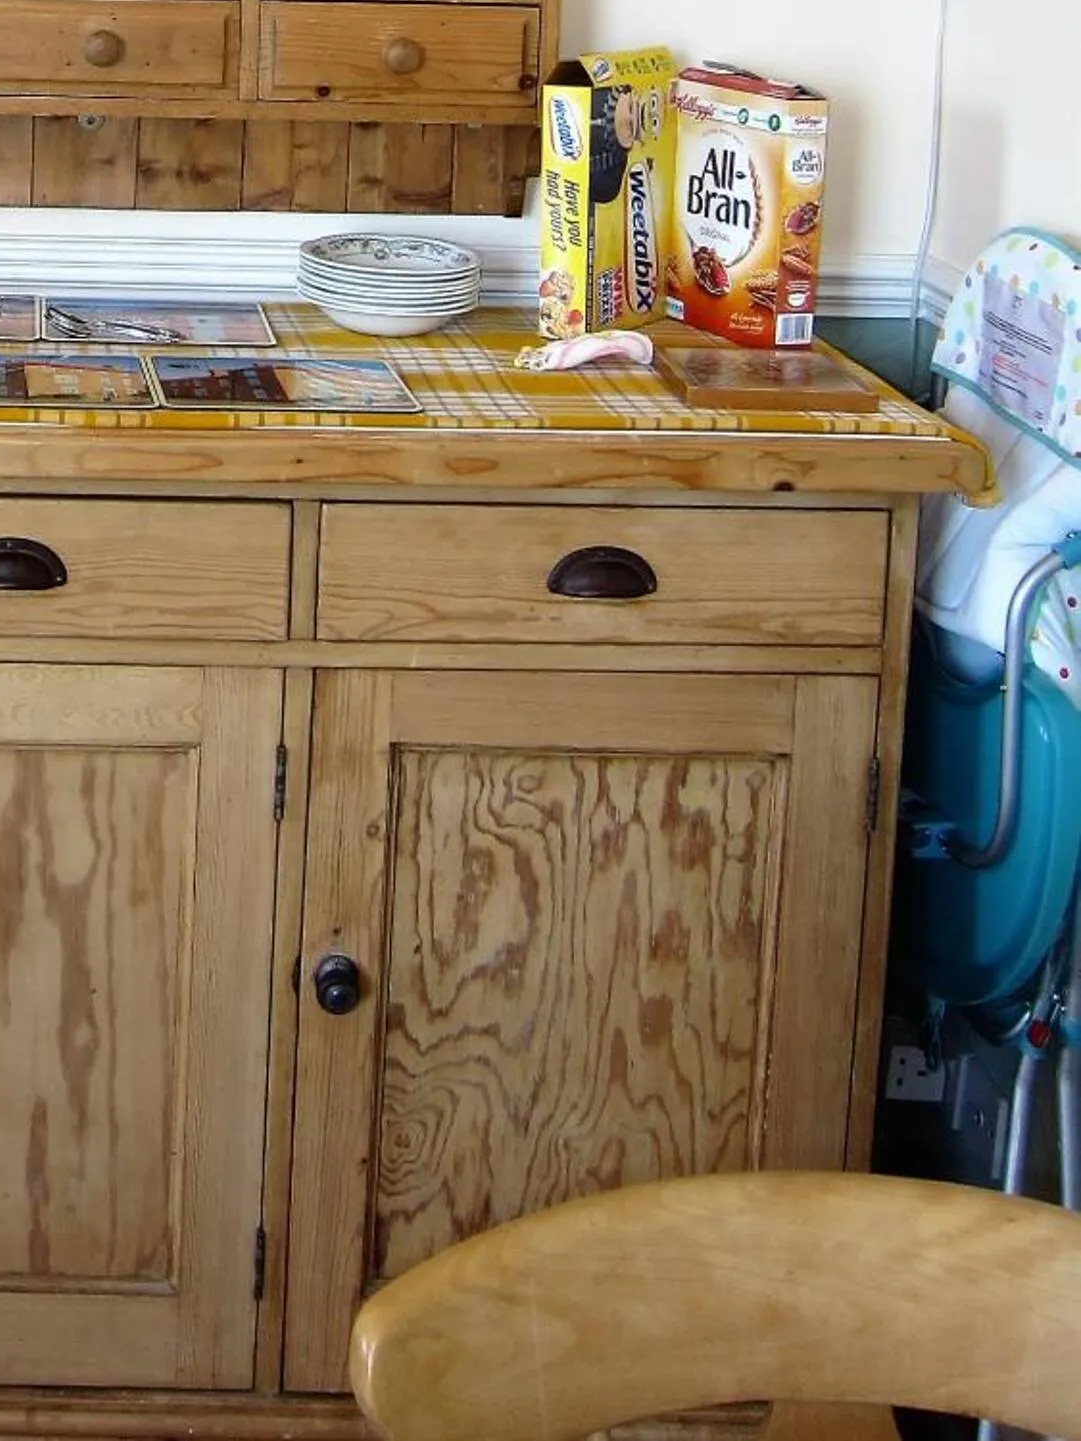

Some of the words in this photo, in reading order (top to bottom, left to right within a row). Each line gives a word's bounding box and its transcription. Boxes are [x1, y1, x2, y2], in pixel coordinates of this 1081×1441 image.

[545, 169, 562, 201] had
[701, 147, 746, 188] All-
[792, 160, 819, 173] Bran
[564, 179, 581, 217] Have
[687, 175, 751, 229] Bran
[546, 202, 566, 253] yours?
[565, 218, 583, 247] you
